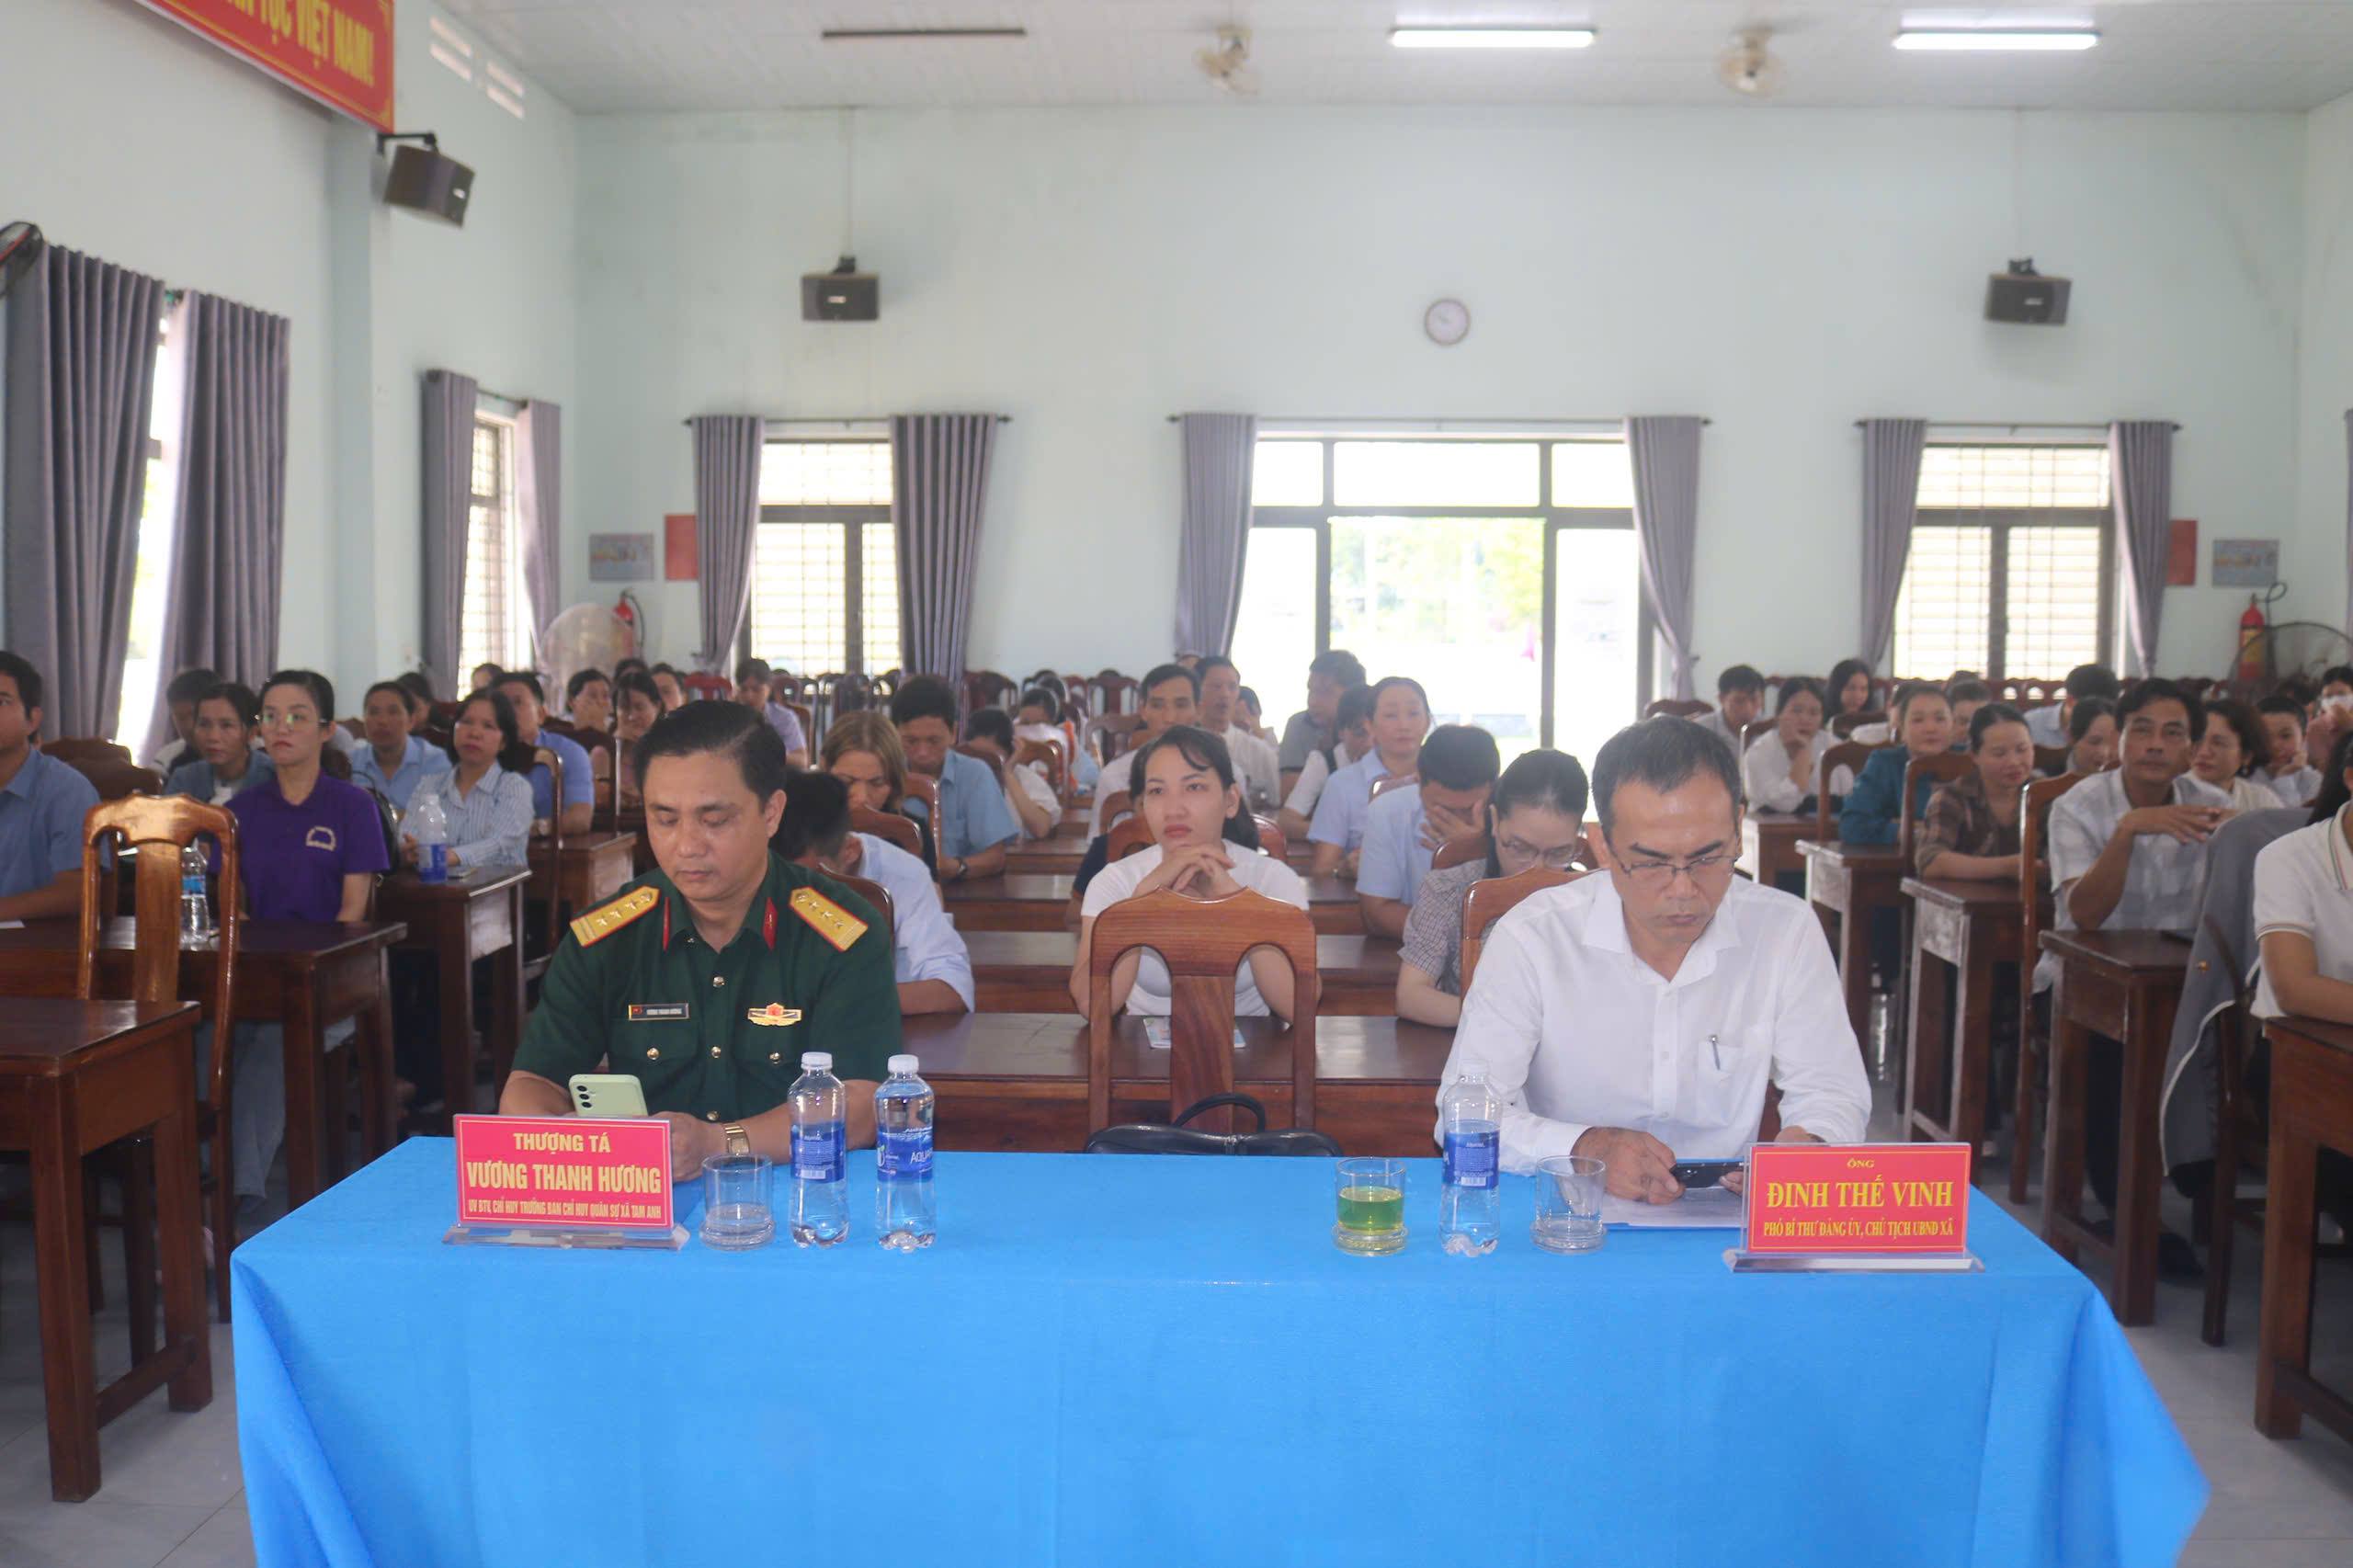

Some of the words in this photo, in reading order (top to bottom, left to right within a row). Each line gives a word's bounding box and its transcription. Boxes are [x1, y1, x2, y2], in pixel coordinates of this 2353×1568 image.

[513, 1132, 584, 1154] THƯỢNG
[589, 1132, 611, 1153] TÁ
[1847, 1158, 1875, 1168] ÔNG
[466, 1160, 529, 1190] VƯƠNG
[532, 1164, 593, 1192] THANH
[598, 1164, 662, 1194] HƯƠNG
[1767, 1182, 1830, 1208] ĐINH
[1836, 1175, 1885, 1208] THẾ
[1892, 1181, 1954, 1207] VINH
[506, 1200, 518, 1214] HUY
[547, 1201, 563, 1216] BAN
[575, 1202, 588, 1217] HUY
[609, 1202, 620, 1221] SỰ
[620, 1200, 631, 1218] XÃ
[631, 1205, 645, 1219] TAM
[646, 1205, 662, 1219] ANH
[1764, 1217, 1784, 1236] PHÓ
[1786, 1218, 1796, 1236] BÍ
[1798, 1220, 1819, 1236] THƯ
[1820, 1217, 1847, 1236] ĐẢNG
[1865, 1216, 1886, 1236] CHỦ
[1887, 1221, 1912, 1242] TỊCH
[1913, 1221, 1938, 1236] UBND
[1939, 1217, 1955, 1236] XÃ
